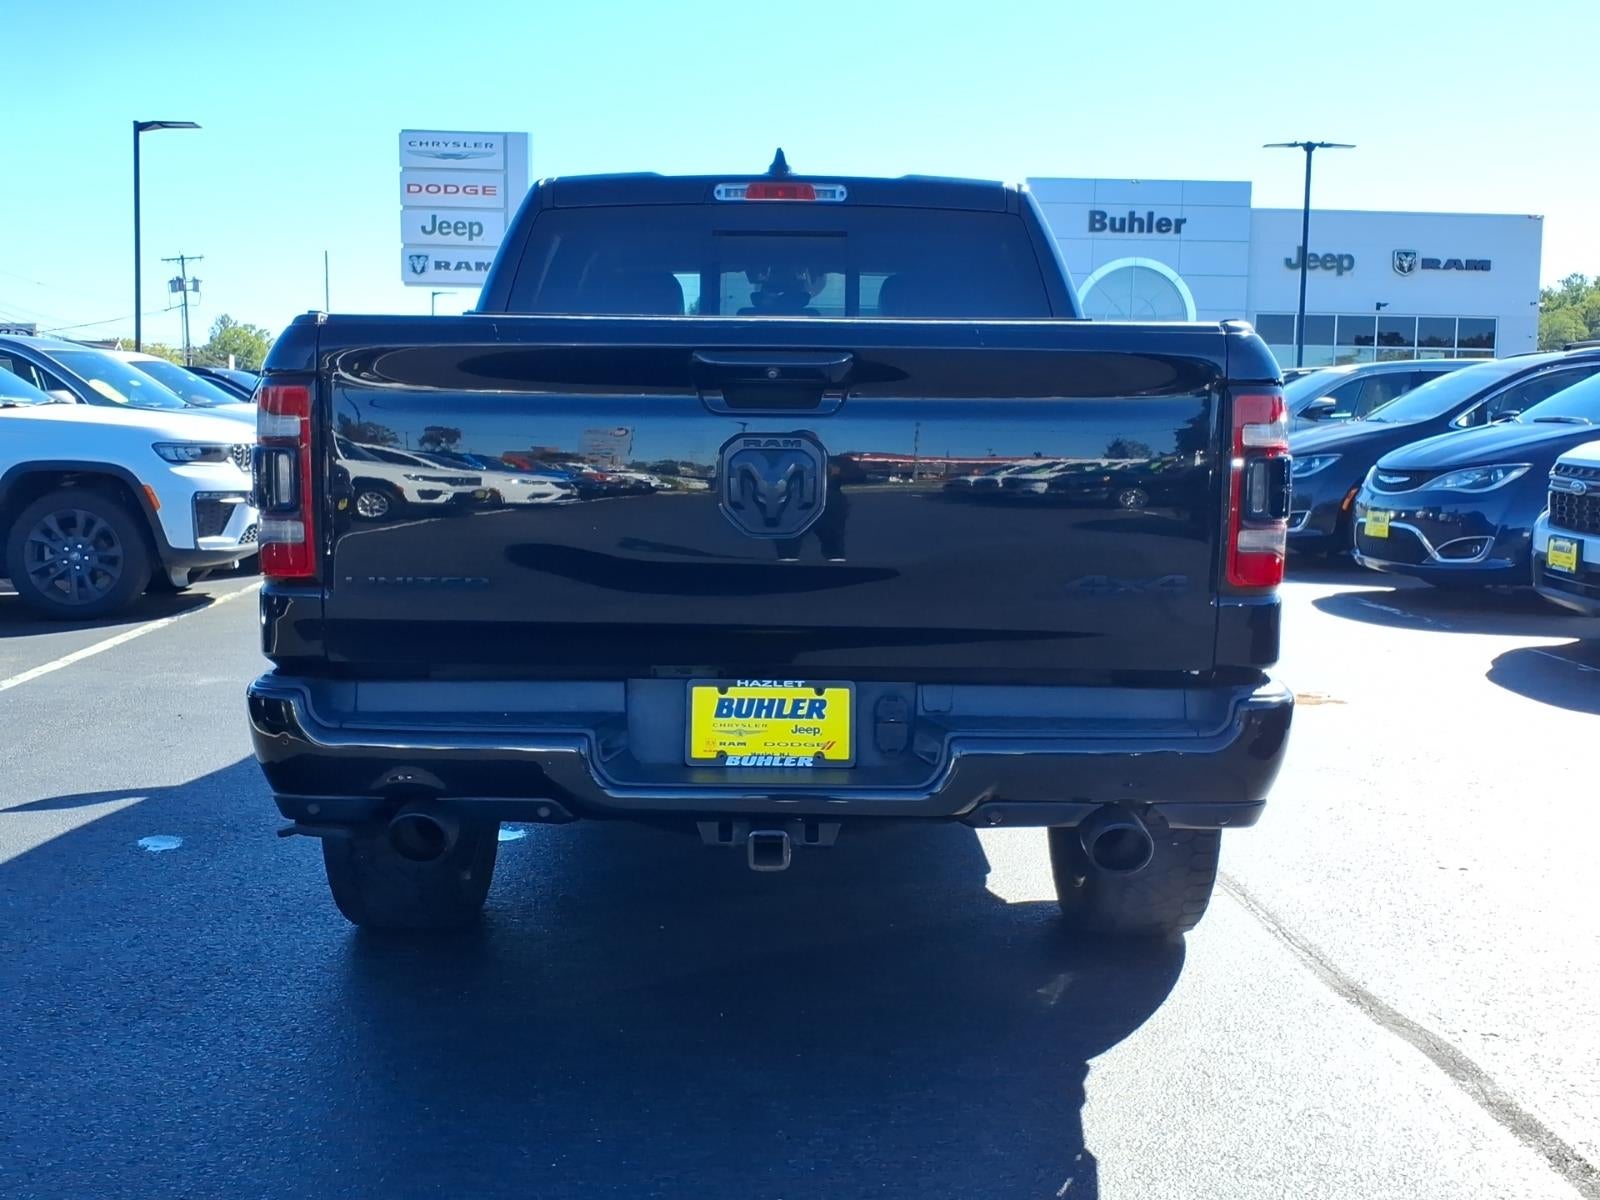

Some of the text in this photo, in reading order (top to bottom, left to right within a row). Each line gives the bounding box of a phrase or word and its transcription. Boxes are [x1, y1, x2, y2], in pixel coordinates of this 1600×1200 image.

[408, 140, 494, 149] CHRYSLER
[406, 183, 497, 196] DODGE
[420, 214, 484, 241] Jeep
[1088, 210, 1187, 234] Buhler
[434, 260, 493, 272] RAM
[1284, 246, 1355, 276] Jeep
[1421, 257, 1491, 271] RAM
[736, 679, 806, 688] HAZLET
[715, 698, 827, 719] BUHLER
[791, 725, 821, 737] Jeep
[725, 756, 814, 767] BUHLER
